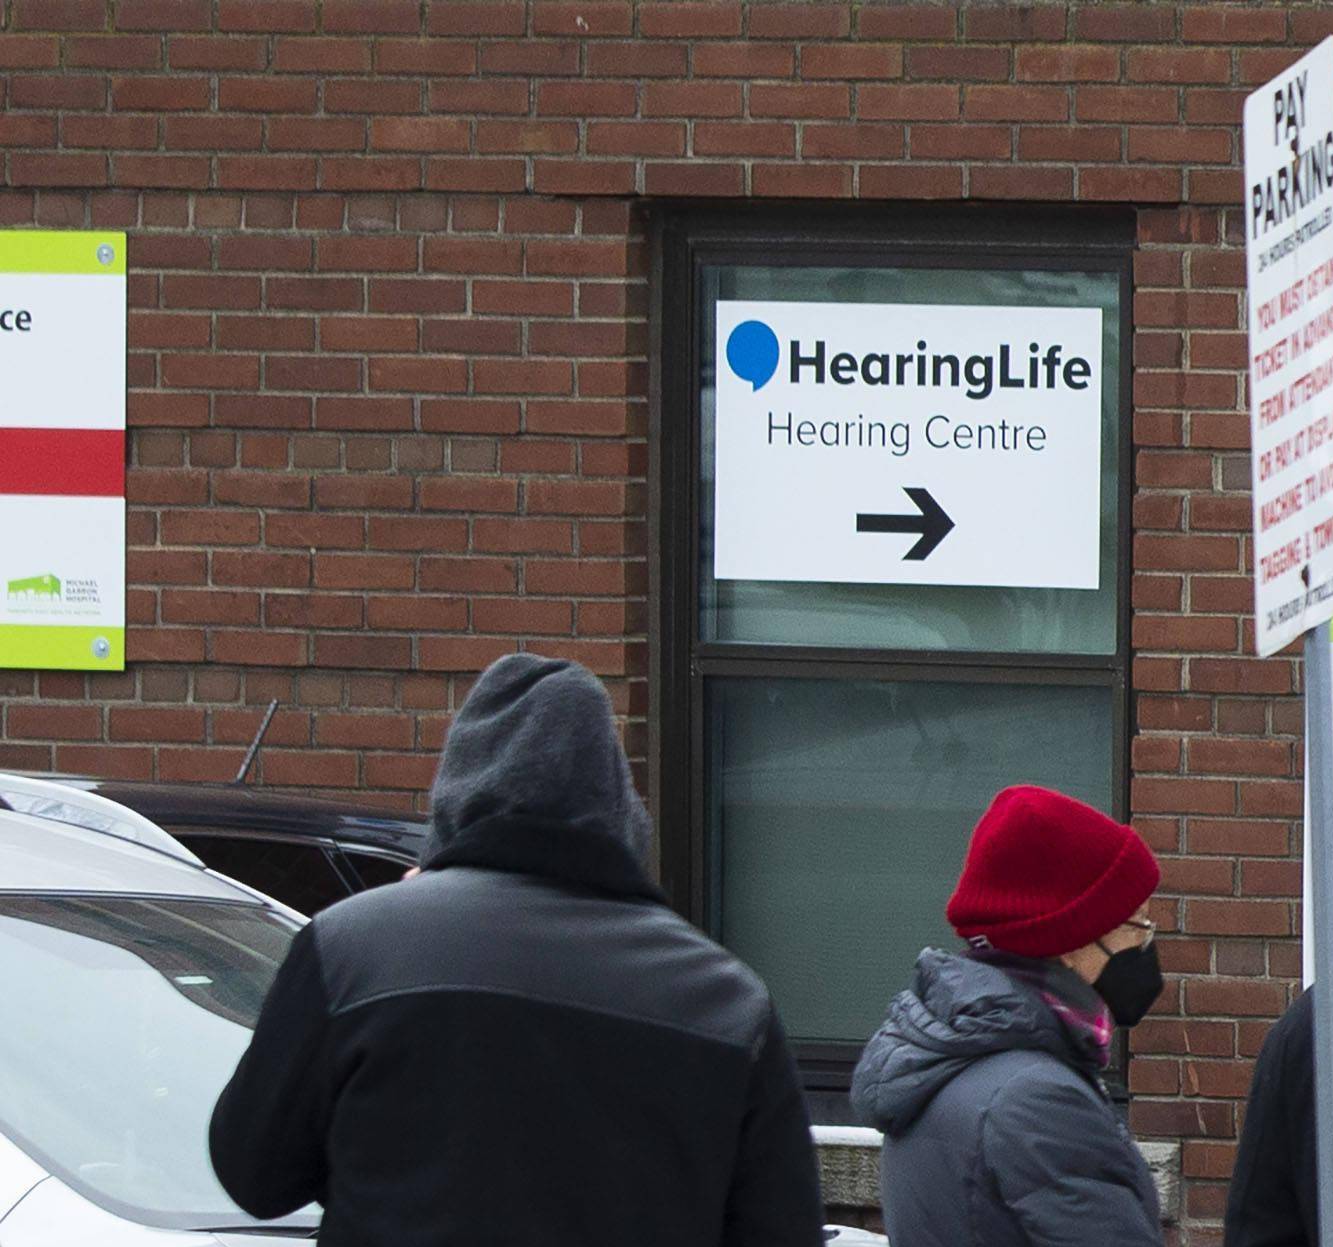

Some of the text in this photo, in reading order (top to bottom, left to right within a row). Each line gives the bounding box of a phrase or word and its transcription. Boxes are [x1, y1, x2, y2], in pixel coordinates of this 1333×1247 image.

[1272, 69, 1309, 146] PAY
[791, 340, 1091, 399] HearingLife
[768, 412, 1046, 456] Hearing Centre
